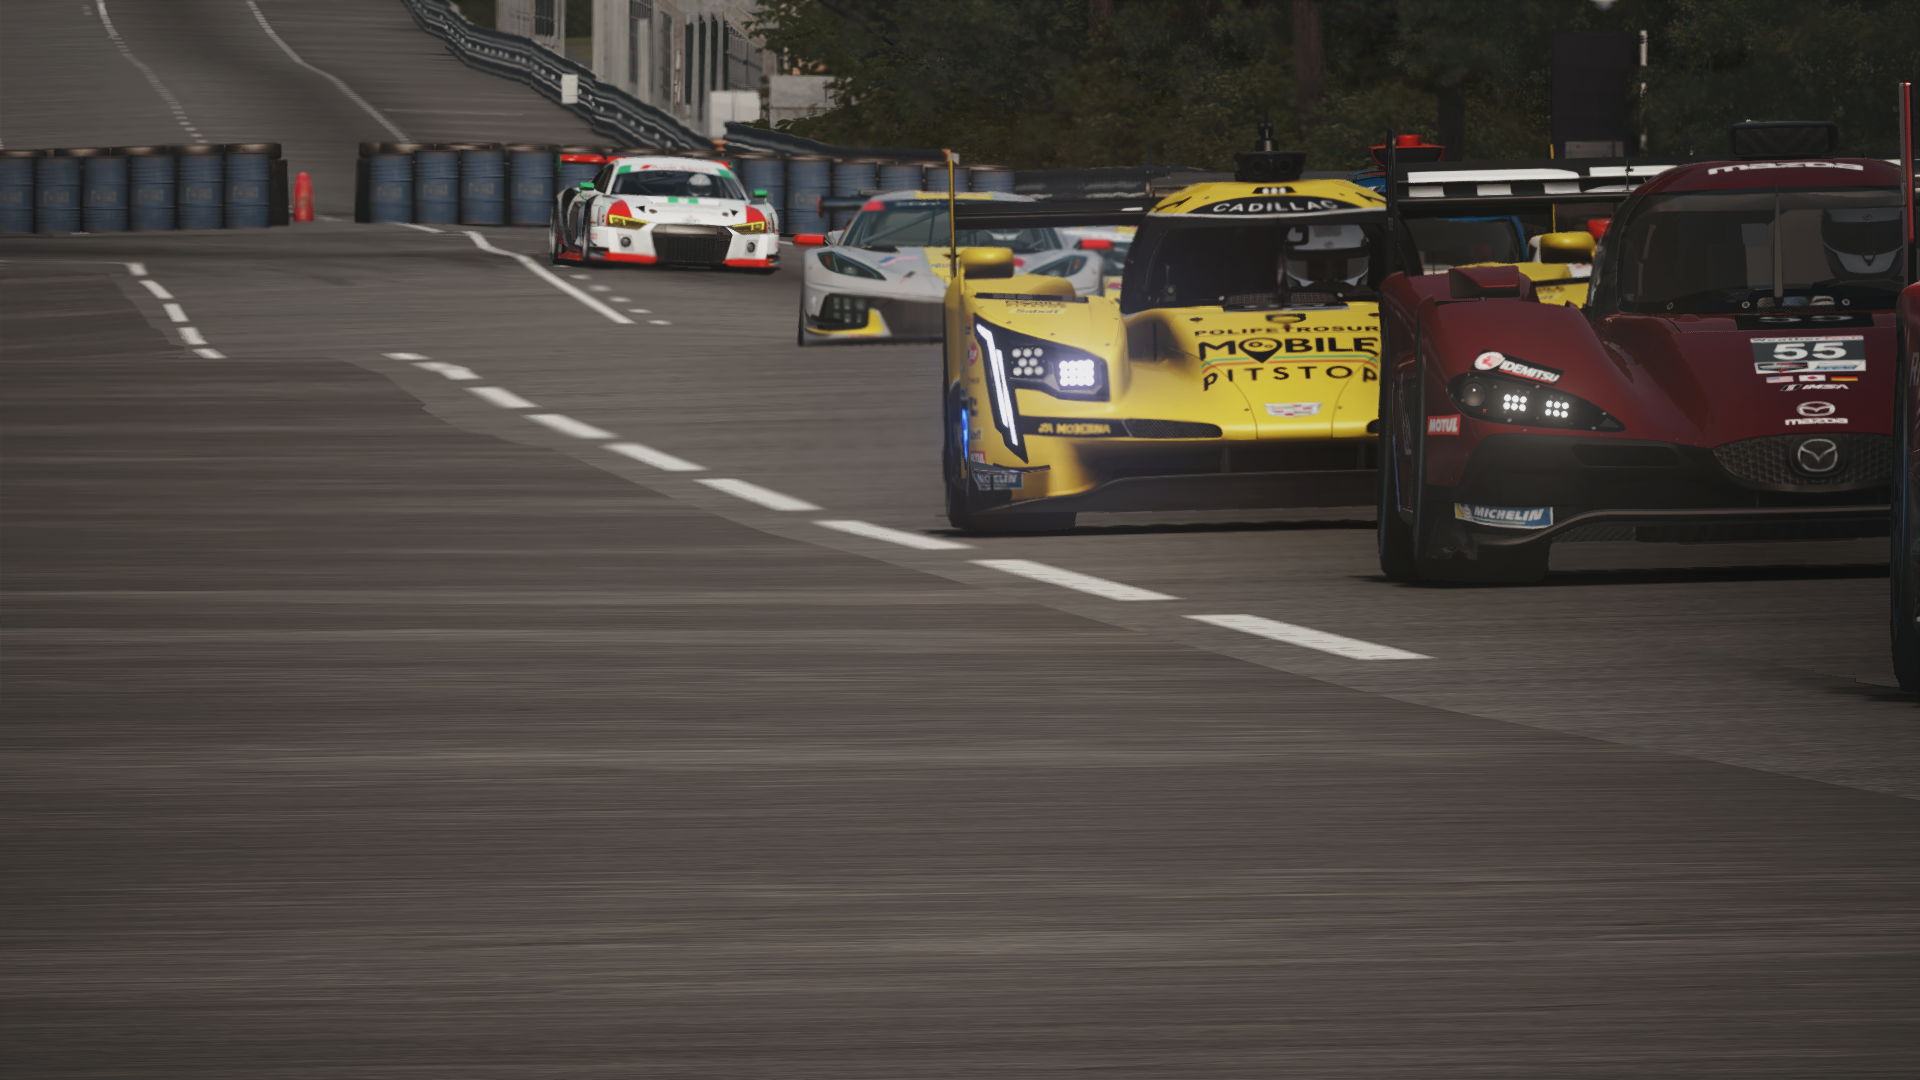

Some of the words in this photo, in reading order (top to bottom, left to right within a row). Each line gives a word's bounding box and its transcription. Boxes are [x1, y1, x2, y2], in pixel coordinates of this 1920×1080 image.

[1212, 200, 1338, 213] CADILLAC
[1198, 337, 1379, 364] MOBILE
[1772, 342, 1847, 361] 55
[1203, 365, 1378, 392] PITSTOP
[1499, 359, 1561, 383] IDEMITSU
[1428, 417, 1459, 433] MOTUL
[1473, 506, 1545, 522] MICHELIN
